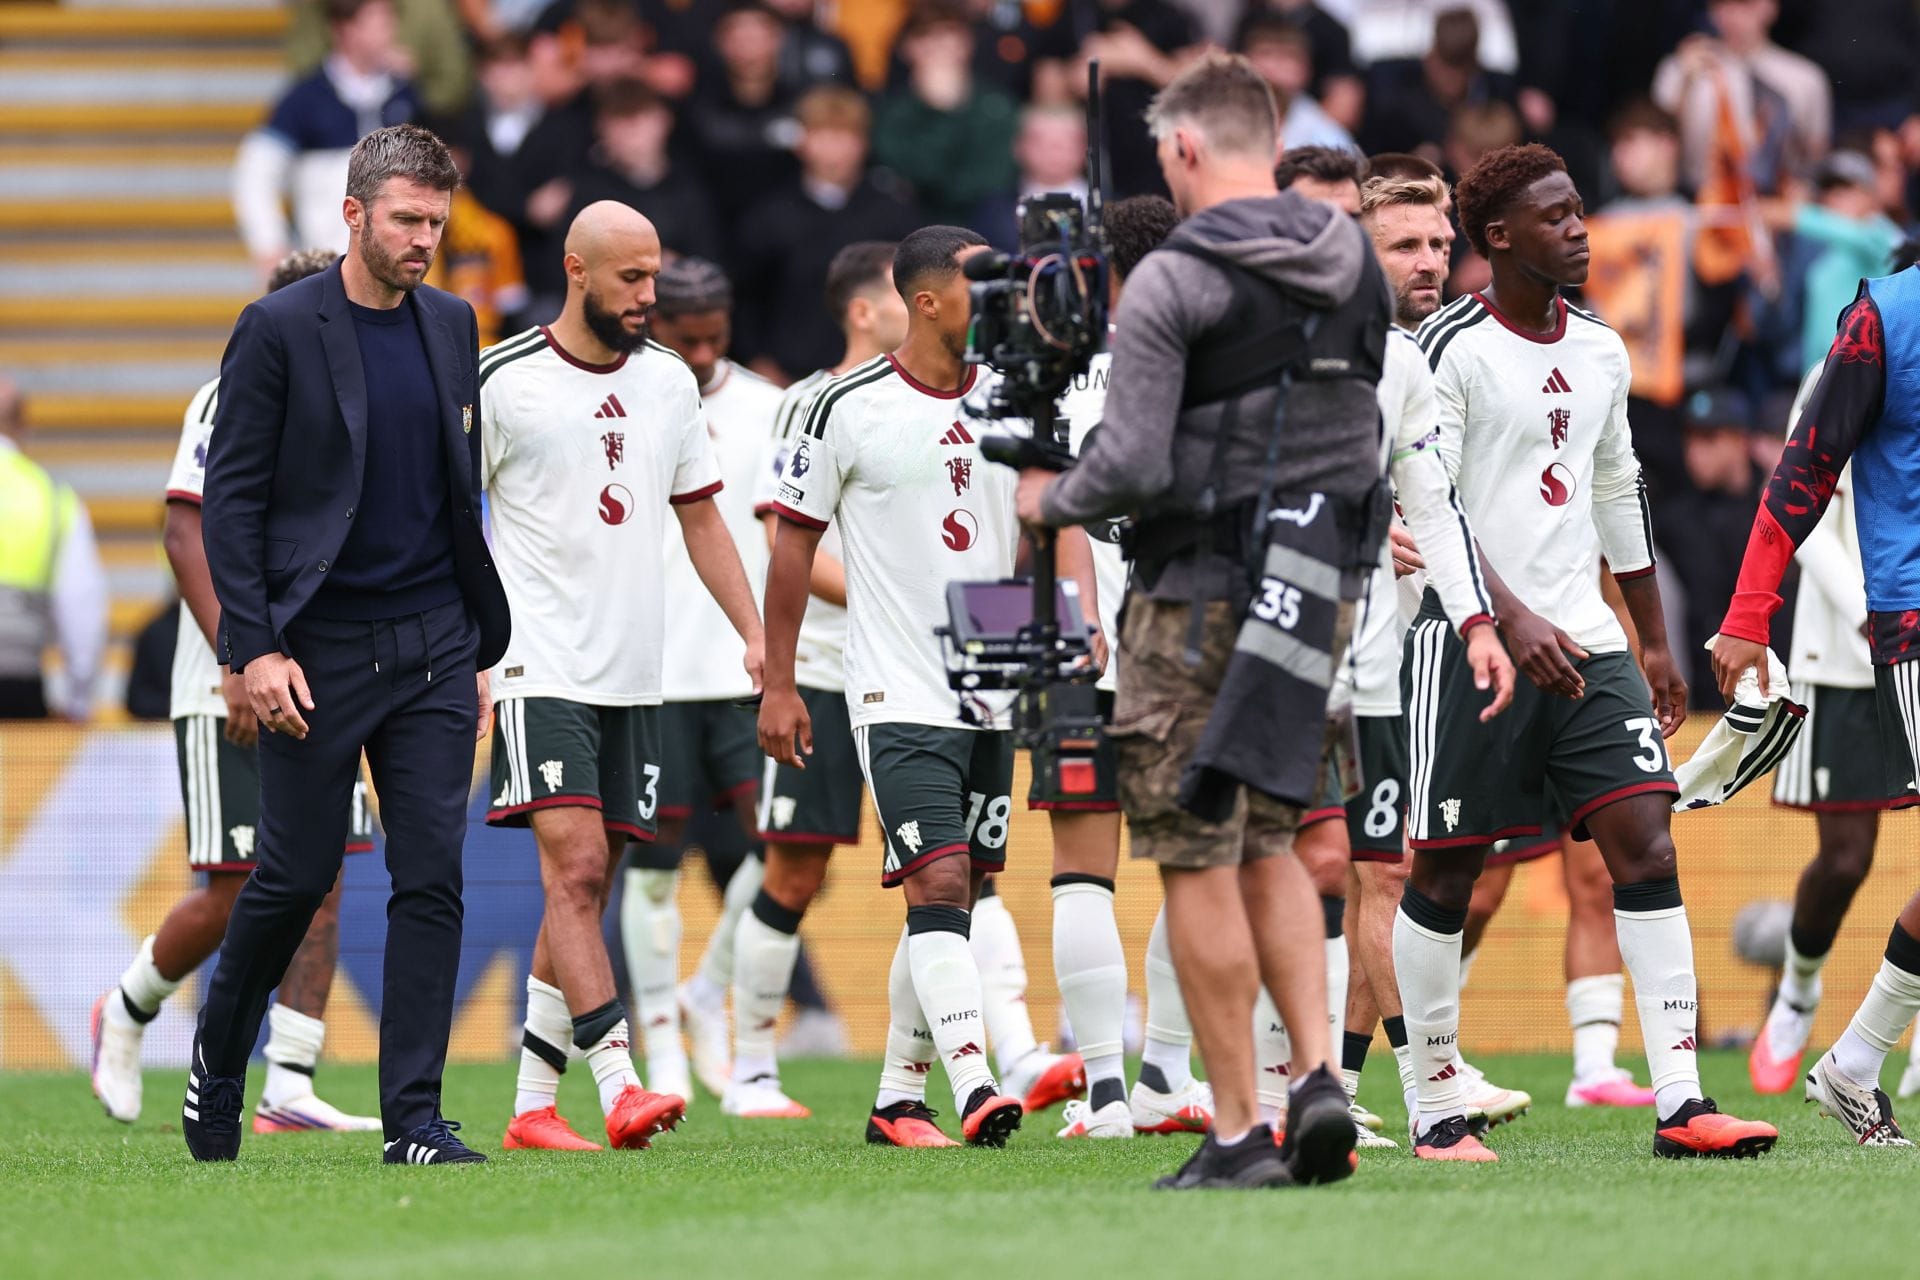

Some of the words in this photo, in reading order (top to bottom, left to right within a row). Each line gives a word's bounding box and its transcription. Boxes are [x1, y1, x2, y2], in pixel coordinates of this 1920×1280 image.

[1624, 717, 1672, 773] 3
[637, 763, 660, 820] 3
[1364, 778, 1400, 838] 8
[965, 790, 1011, 849] 18
[940, 1009, 978, 1026] MUFC
[1663, 999, 1697, 1011] MUF
[913, 1028, 934, 1041] MU
[1427, 1029, 1457, 1046] MUF
